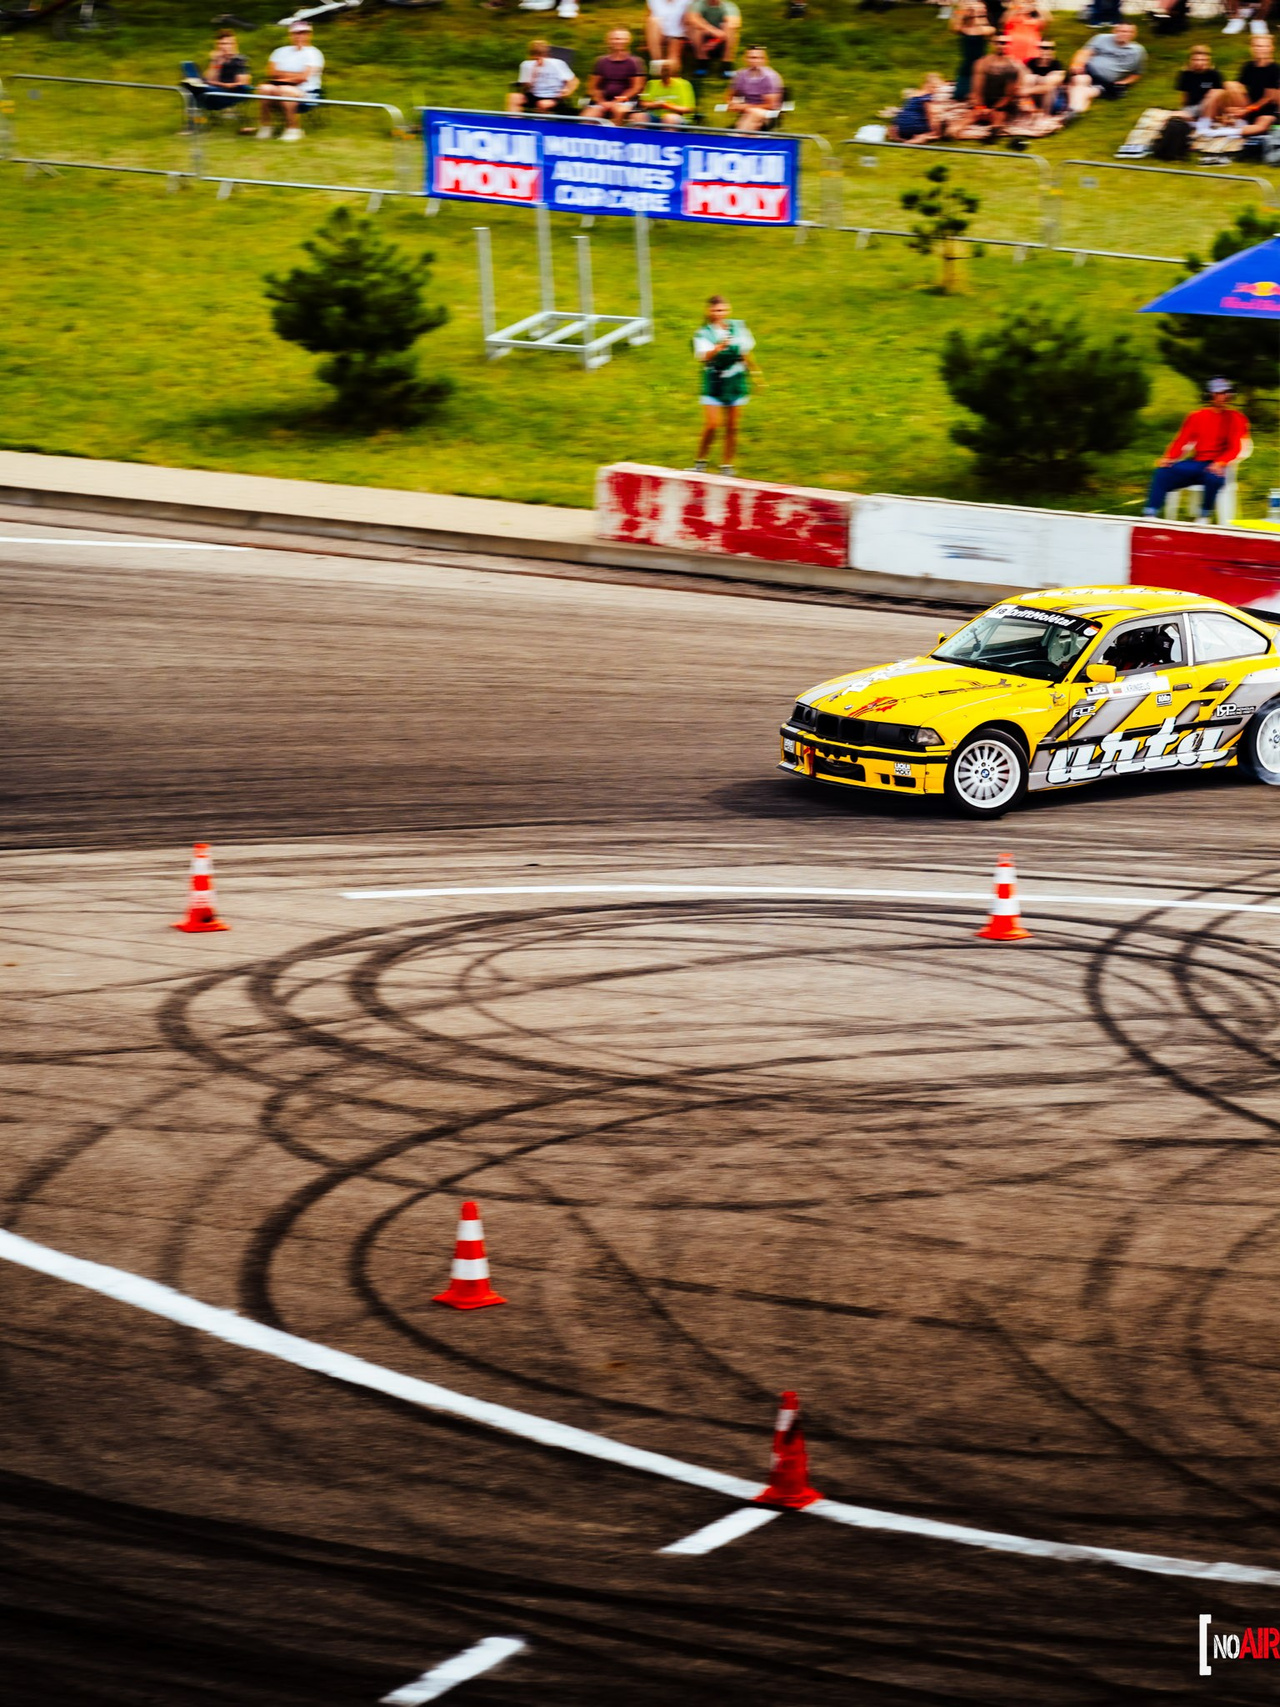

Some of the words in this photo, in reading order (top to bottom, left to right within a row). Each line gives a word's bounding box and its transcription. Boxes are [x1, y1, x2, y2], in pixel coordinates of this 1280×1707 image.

[438, 126, 537, 164] LIQUI
[437, 160, 542, 198] MOLY
[687, 150, 785, 184] LIQUI
[685, 184, 791, 218] MOLY
